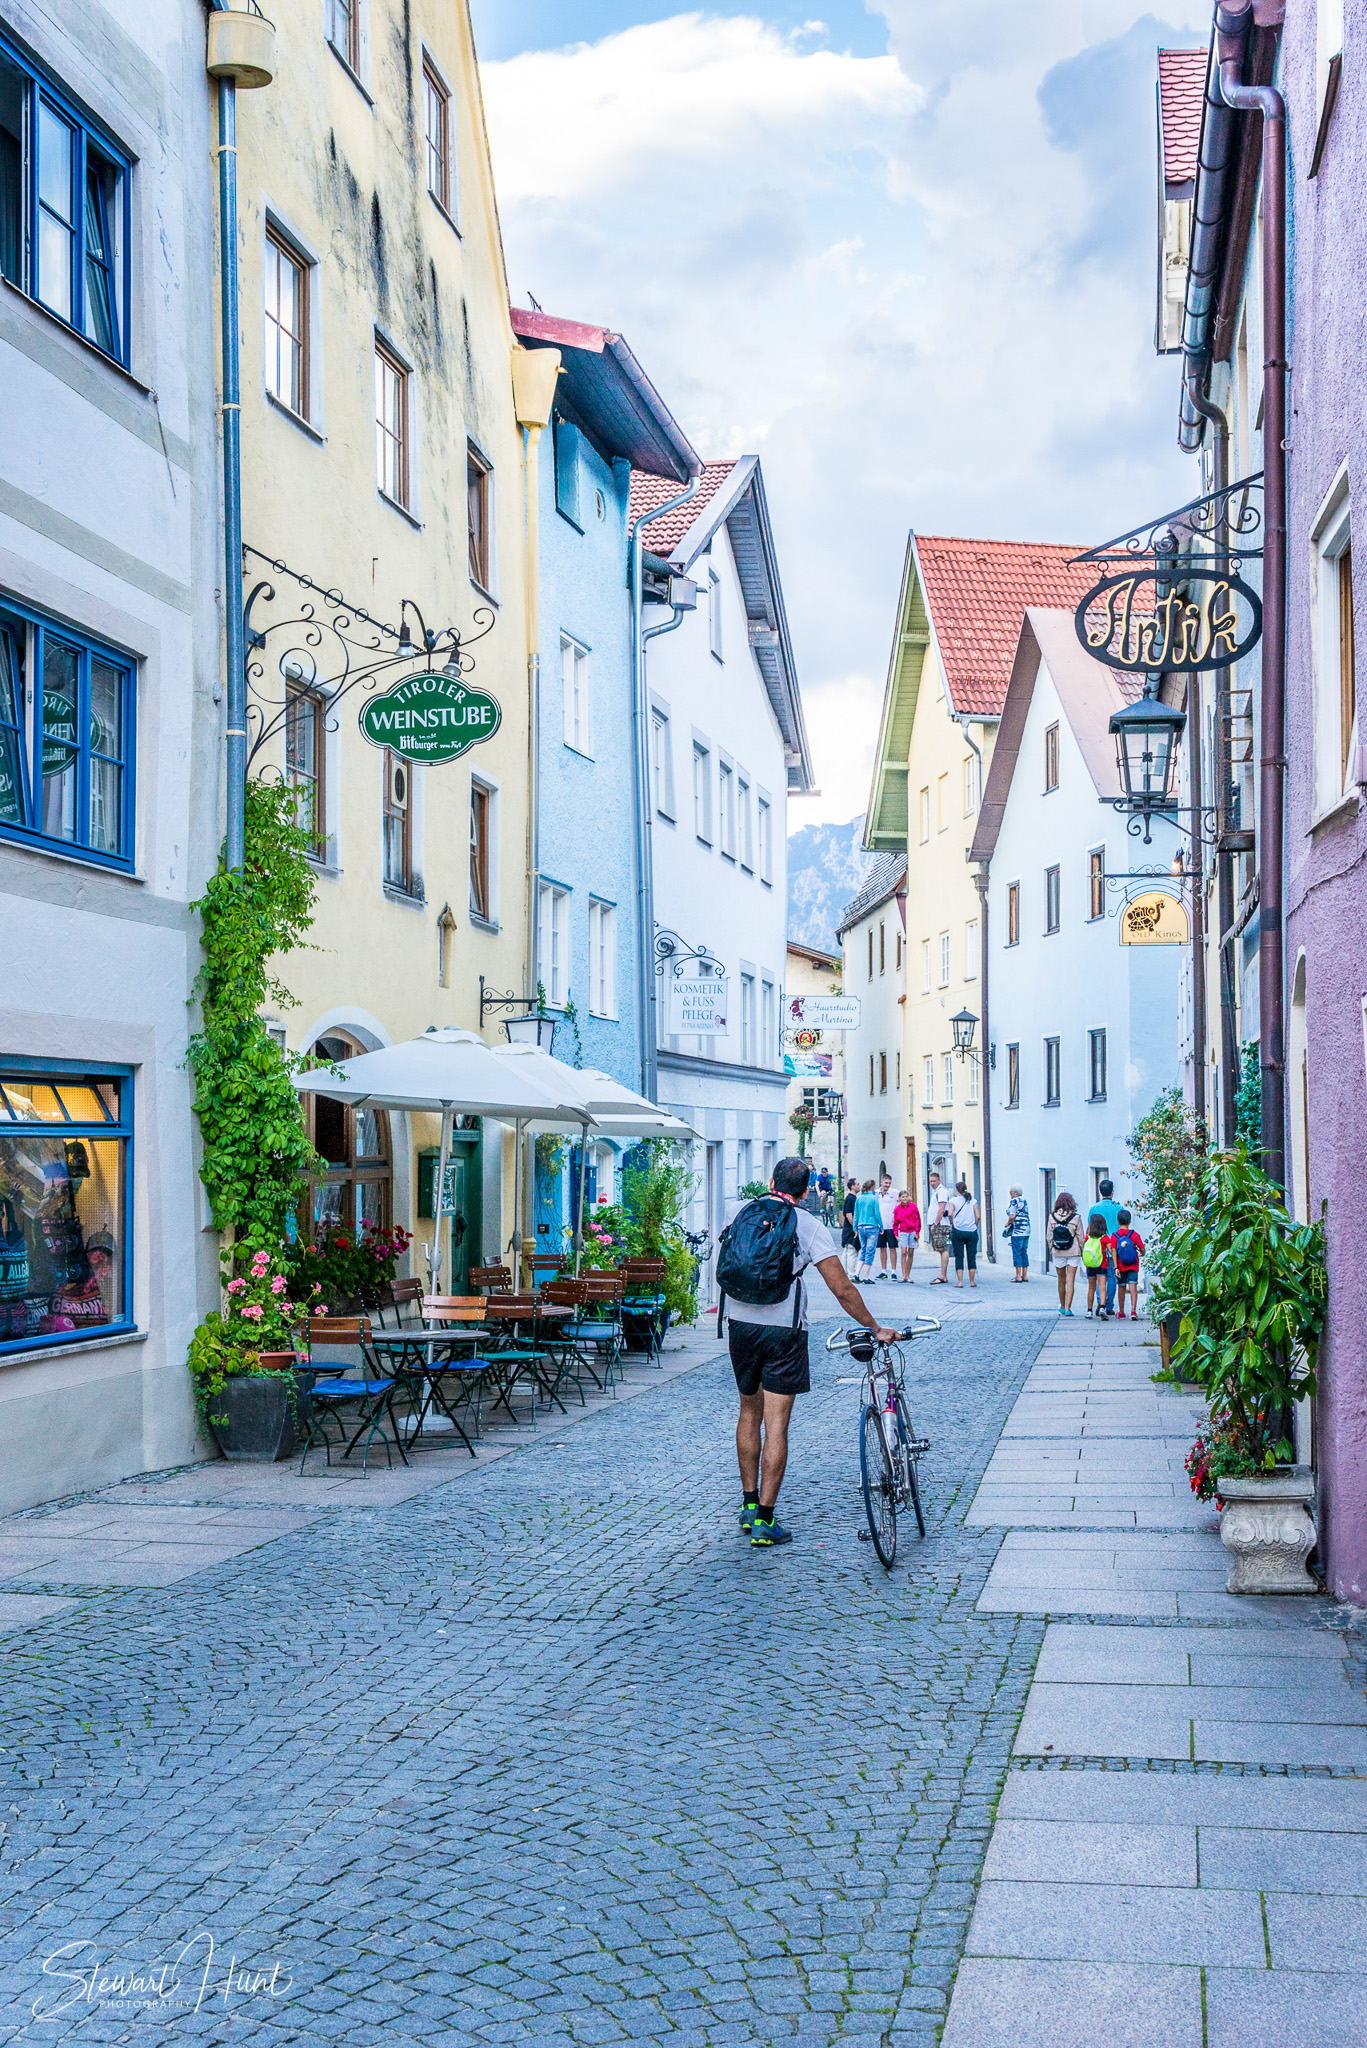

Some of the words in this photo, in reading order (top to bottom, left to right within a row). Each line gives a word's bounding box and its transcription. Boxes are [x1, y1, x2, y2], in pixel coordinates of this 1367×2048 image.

[1087, 578, 1239, 666] Antik
[393, 679, 466, 705] TIROLER
[370, 705, 492, 731] WEINSTUBE
[399, 735, 438, 751] Bitburger
[673, 983, 724, 994] KOSMETIK
[682, 996, 690, 1007] &
[692, 996, 715, 1007] FUSS
[807, 1001, 857, 1011] Haarstudio
[682, 1009, 715, 1020] PFLEGE
[812, 1013, 853, 1023] Martina
[52, 1297, 106, 1315] GERMANY
